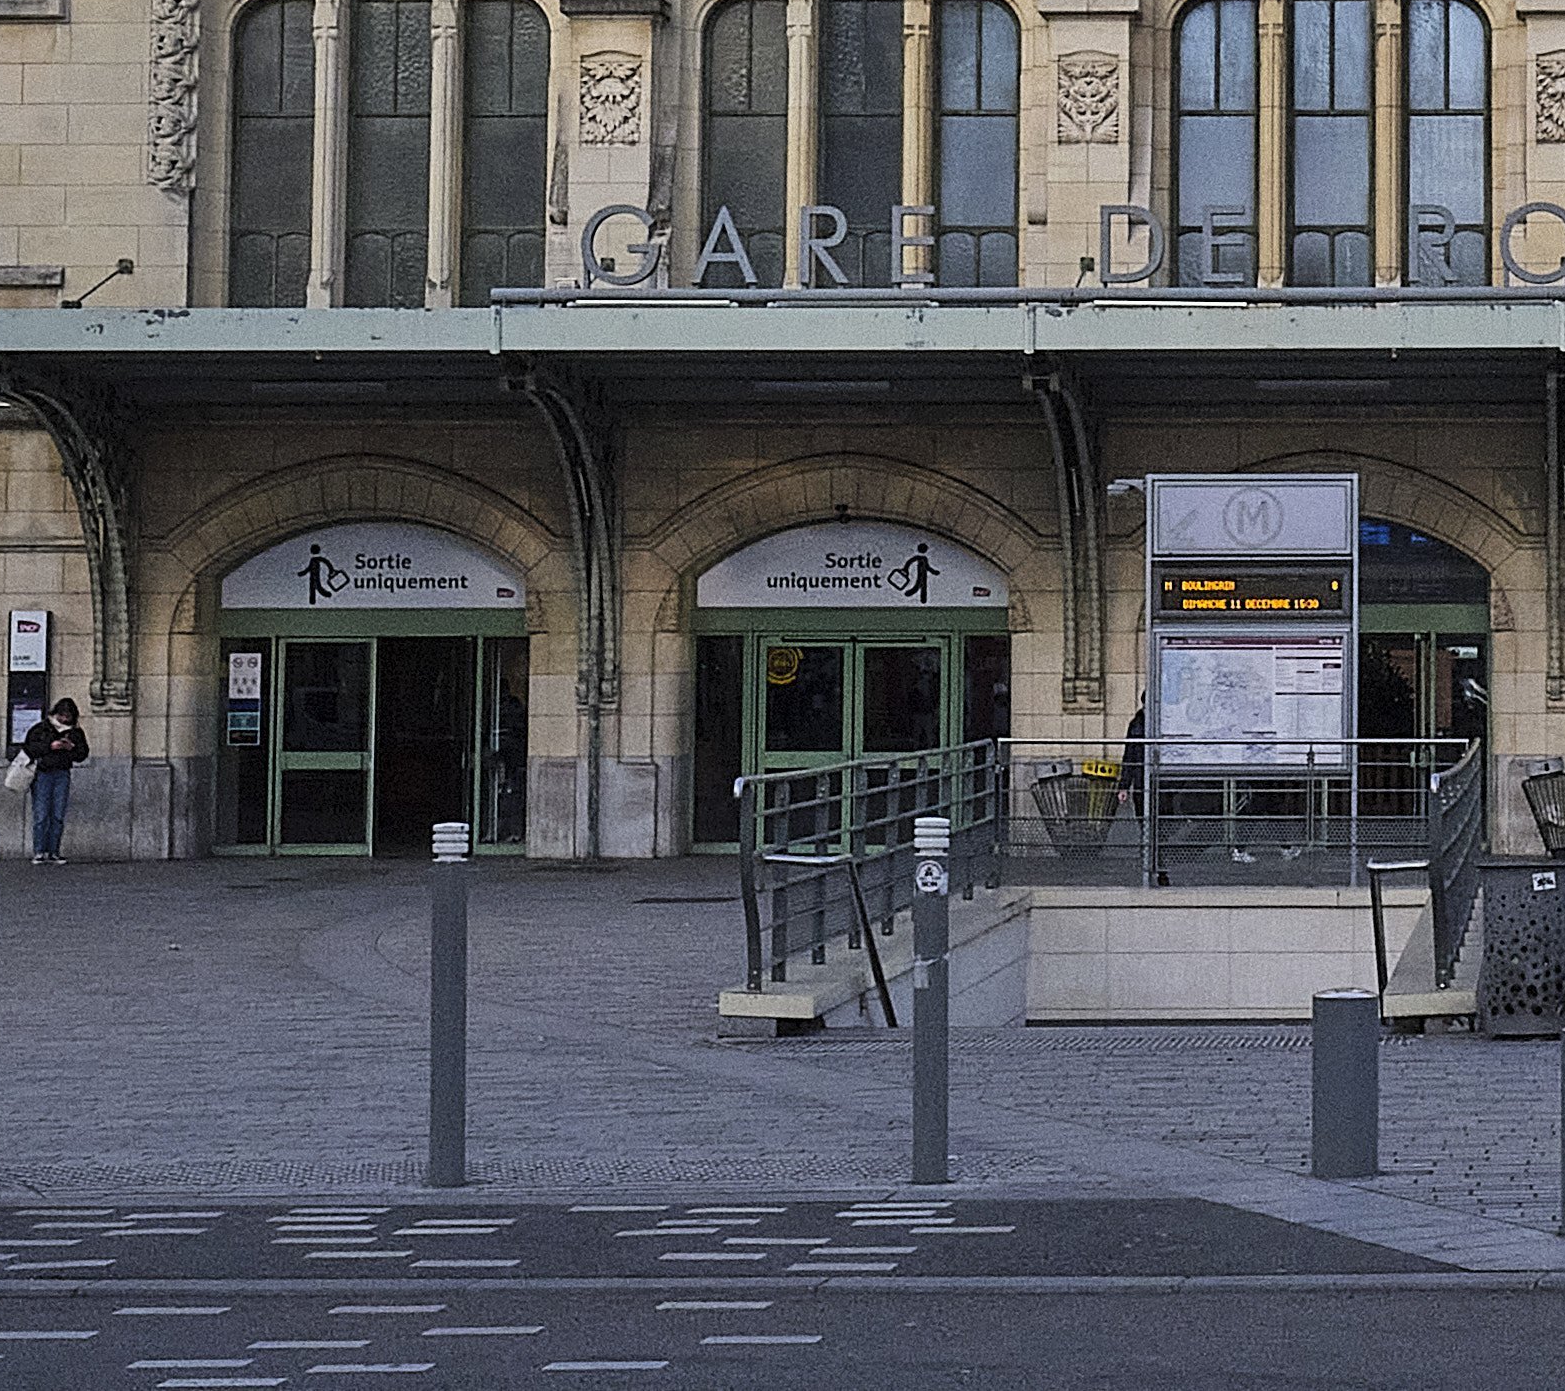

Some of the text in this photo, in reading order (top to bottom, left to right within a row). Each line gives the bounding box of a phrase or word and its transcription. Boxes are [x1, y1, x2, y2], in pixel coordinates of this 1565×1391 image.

[581, 204, 934, 286] GARE
[1100, 204, 1246, 285] DE
[355, 553, 412, 569] Sortie
[825, 553, 882, 568] Sortie
[354, 573, 468, 593] uniquement
[767, 572, 882, 592] uniquement
[1230, 599, 1241, 609] 11
